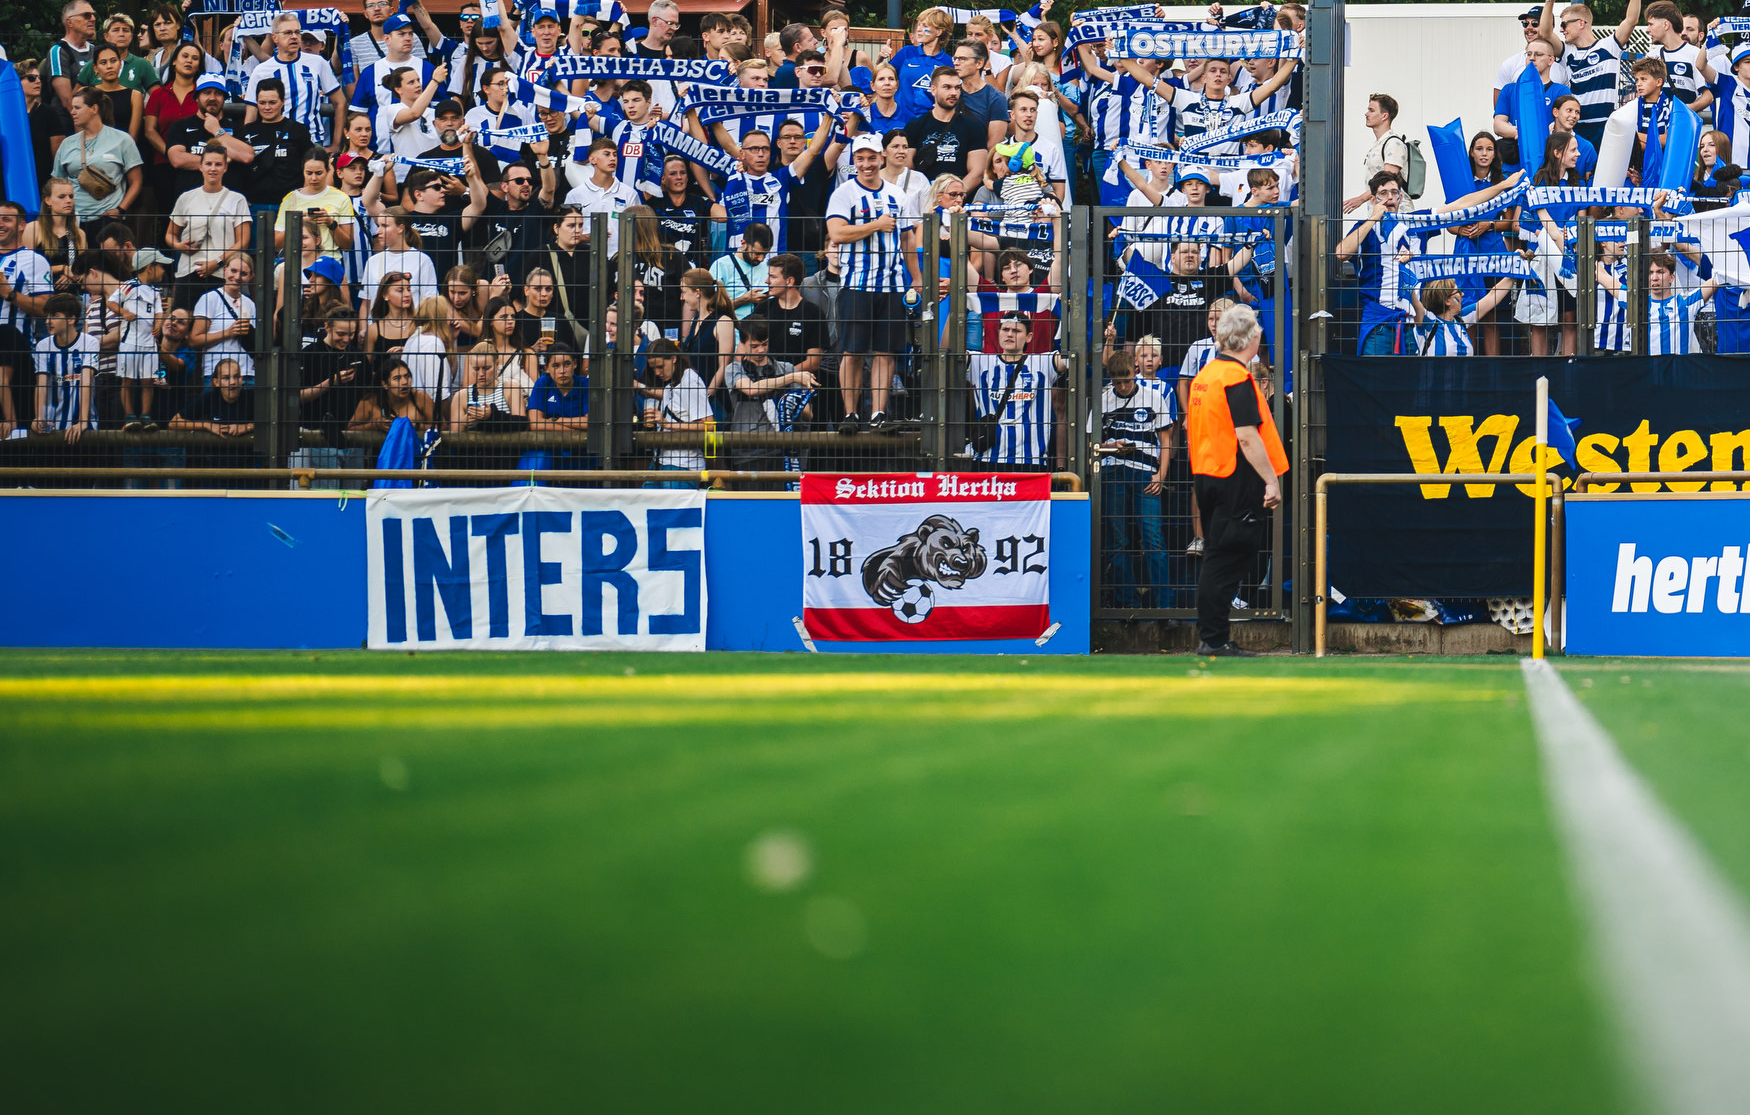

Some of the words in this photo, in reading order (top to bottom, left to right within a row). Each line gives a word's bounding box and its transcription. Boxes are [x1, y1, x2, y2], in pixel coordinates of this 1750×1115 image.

[1130, 31, 1278, 58] OSTKURVE
[555, 55, 664, 76] HERTHA
[671, 59, 727, 80] BSC
[689, 84, 781, 104] Hertha
[1181, 120, 1230, 151] BERLINER
[1231, 111, 1292, 134] SPORT-CLUB
[626, 142, 640, 154] DB
[1134, 148, 1175, 161] VEREINT
[1179, 153, 1214, 165] GEGEN
[1215, 157, 1240, 167] ALLE
[1529, 187, 1604, 205] HERTHA
[1469, 256, 1530, 275] FRAUEN
[835, 477, 925, 499] Sektion
[936, 473, 1017, 501] Hertha
[807, 537, 853, 578] 18
[993, 533, 1047, 575] 92
[383, 508, 702, 644] INTERS
